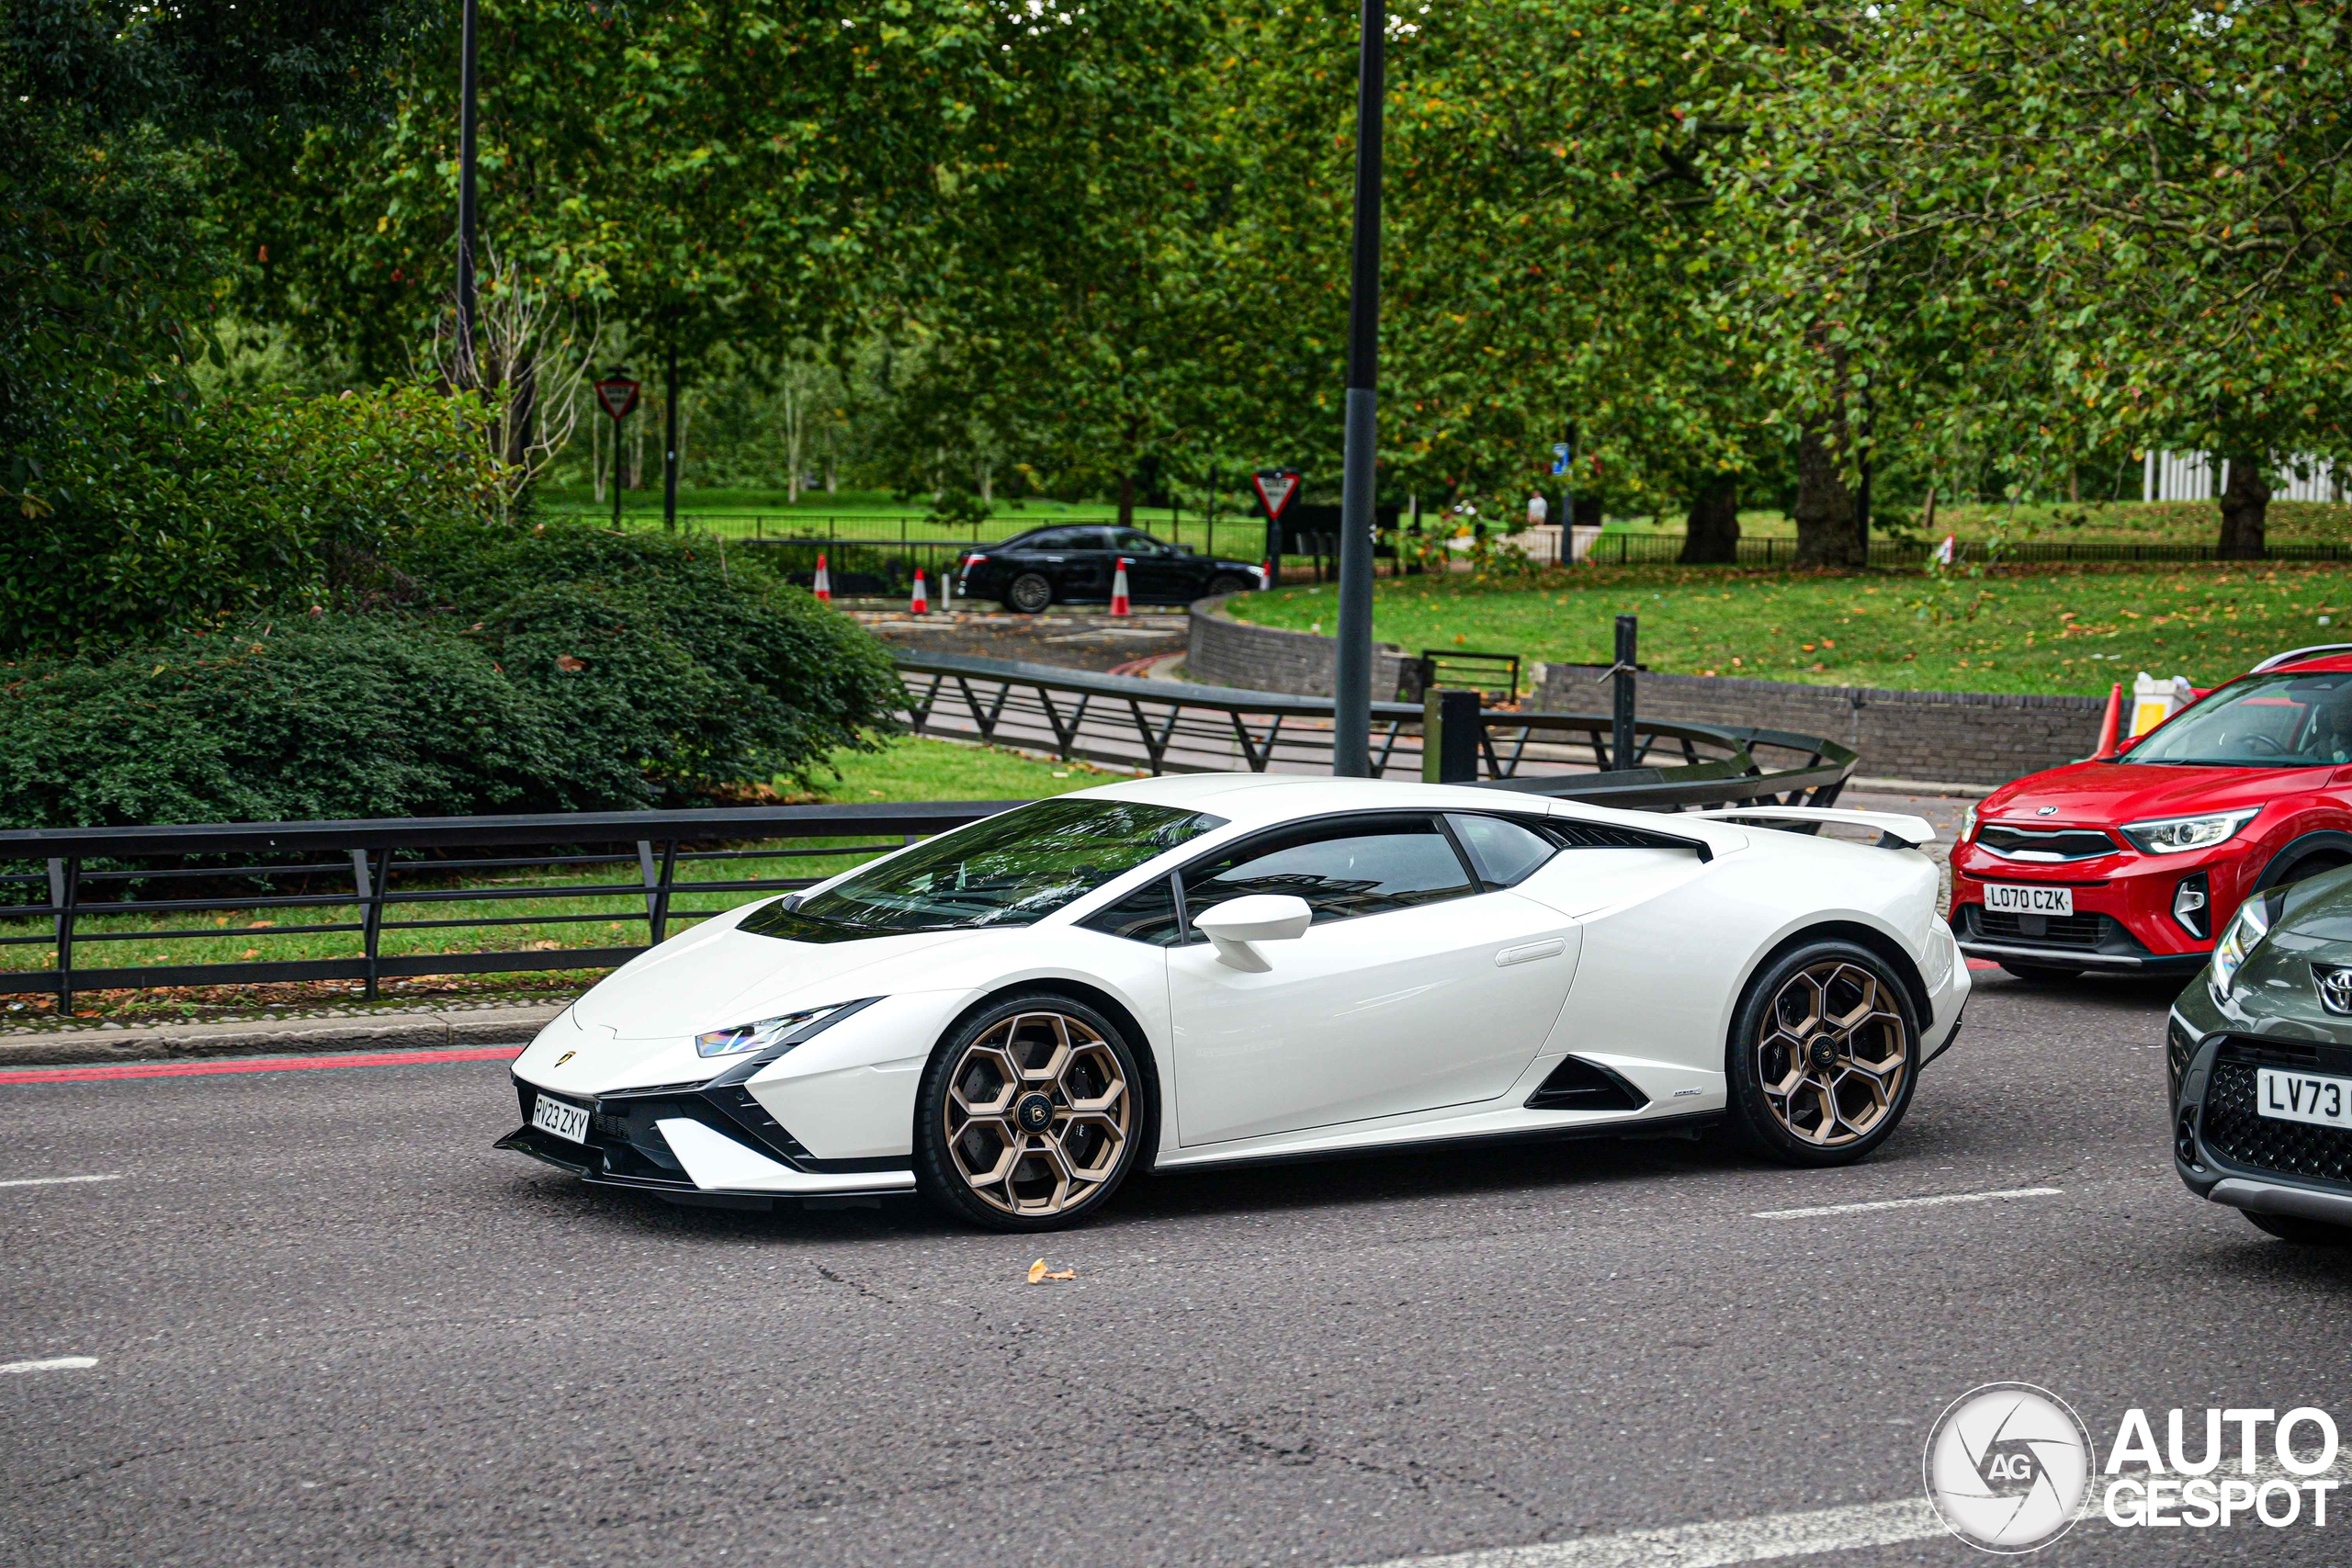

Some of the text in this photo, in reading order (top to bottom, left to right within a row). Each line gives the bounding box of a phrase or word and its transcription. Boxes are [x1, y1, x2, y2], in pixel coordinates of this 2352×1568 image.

[1991, 887, 2065, 911] LO70 CZK
[2269, 1076, 2341, 1118] LV73
[535, 1099, 587, 1138] RV23 ZXY
